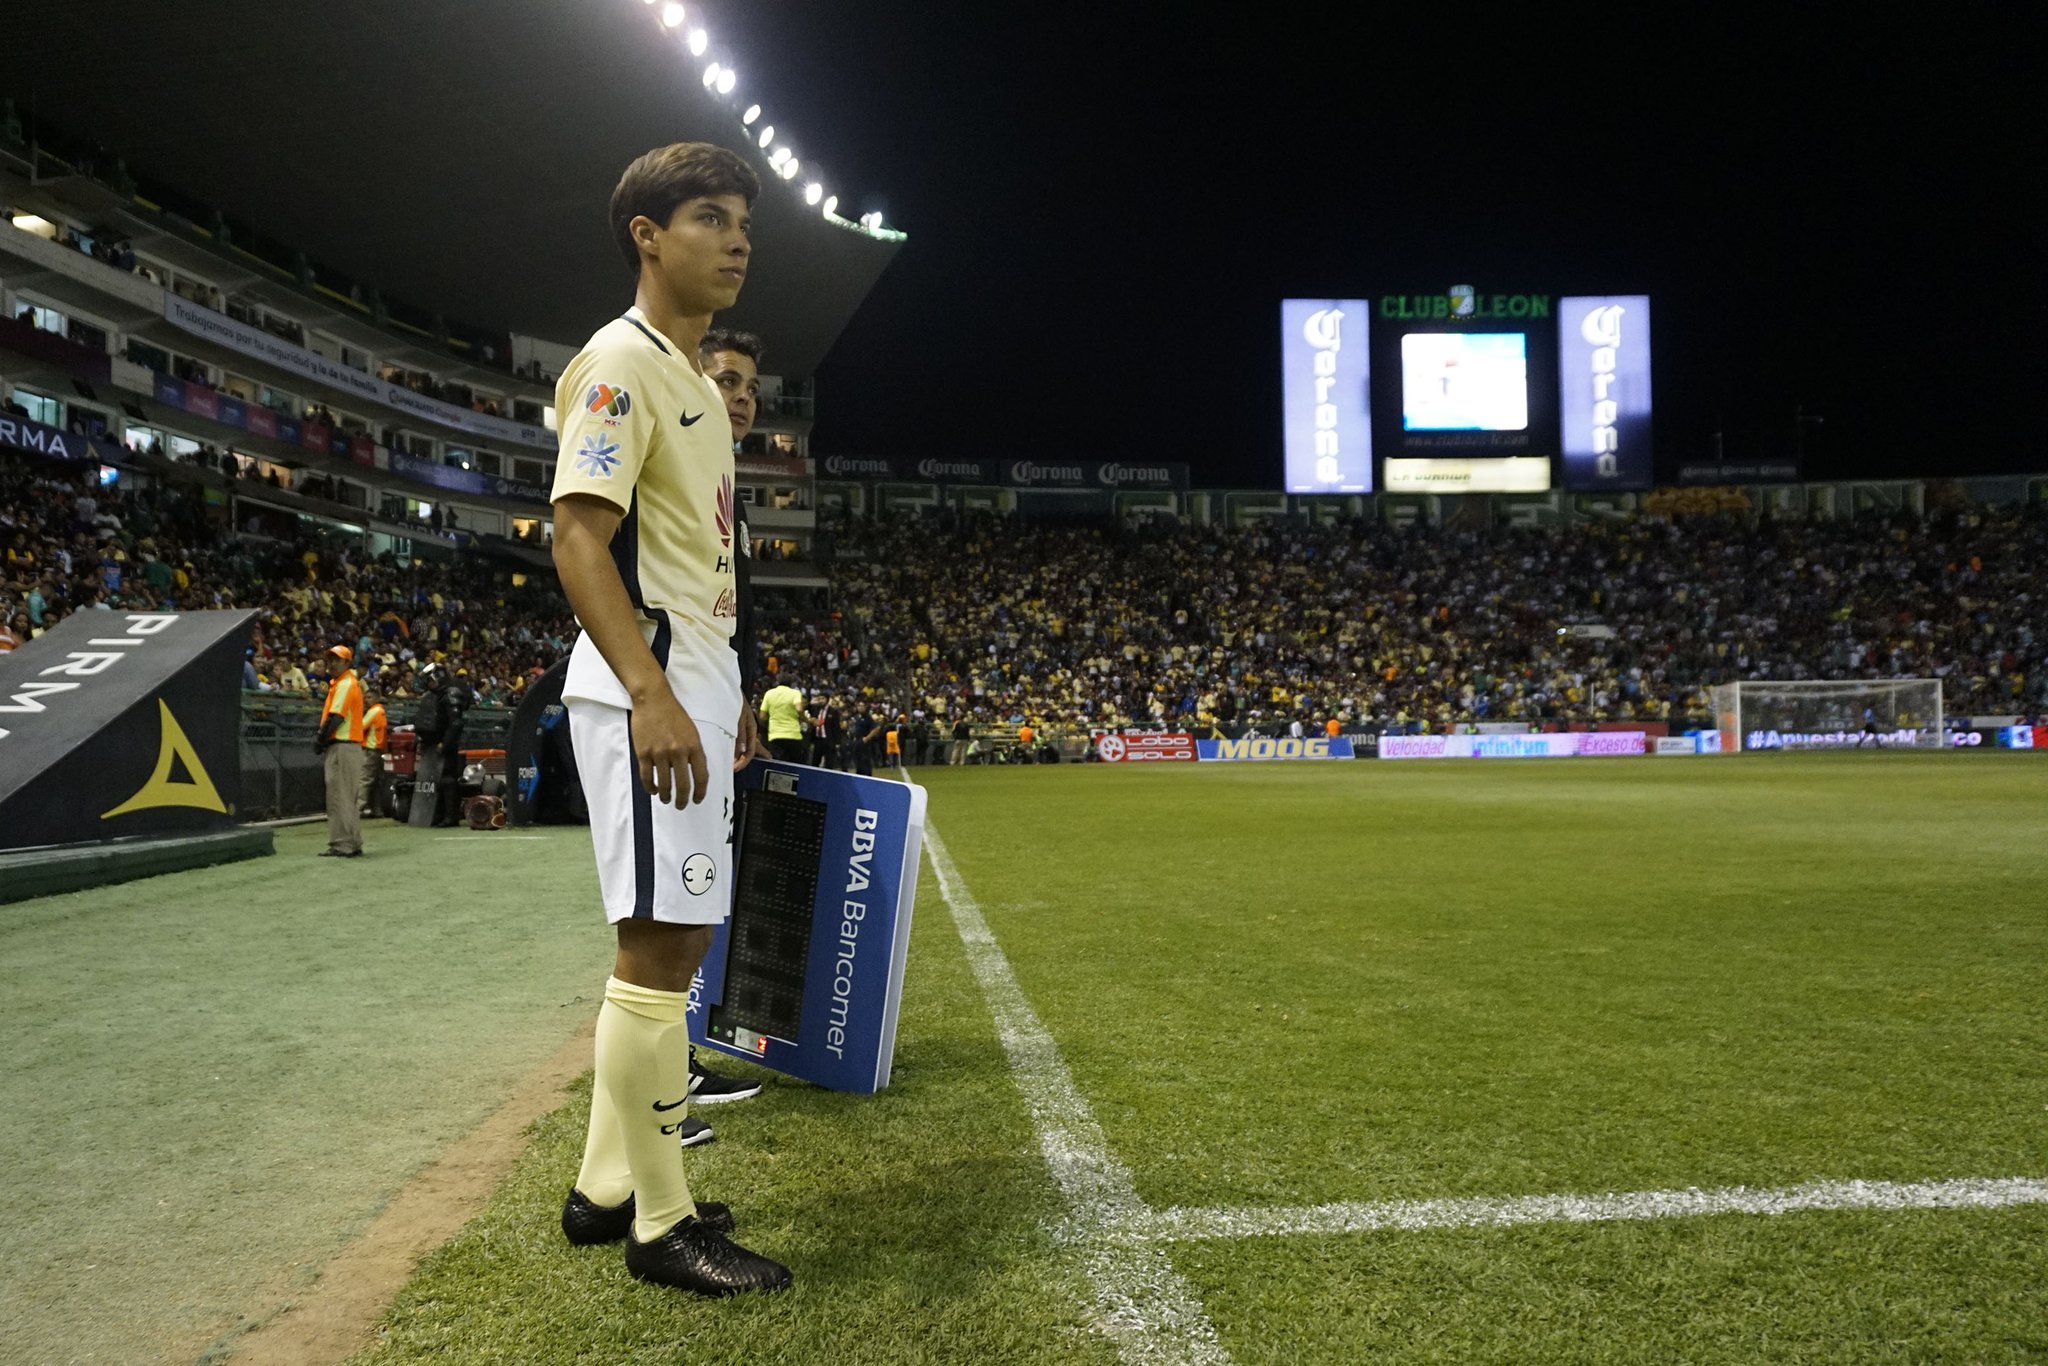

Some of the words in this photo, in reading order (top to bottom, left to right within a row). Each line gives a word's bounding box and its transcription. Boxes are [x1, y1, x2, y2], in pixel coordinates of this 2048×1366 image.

[1380, 294, 1448, 319] CLUB
[1476, 294, 1550, 319] LEON
[174, 304, 235, 338] Trabajamos
[267, 344, 310, 368] seguridad
[1303, 309, 1345, 484] Corona
[1581, 304, 1625, 477] Corona
[825, 455, 888, 476] Corona
[918, 458, 981, 479] Corona
[1011, 460, 1085, 485] Corona
[1098, 462, 1170, 486] Corona
[0, 614, 180, 739] PIRM
[1127, 751, 1192, 760] SOLO
[1217, 737, 1330, 758] MOOG
[1385, 736, 1446, 756] Velocidad
[1583, 735, 1628, 753] Exceso
[846, 808, 879, 892] BBVA
[826, 900, 867, 1060] Bancomer
